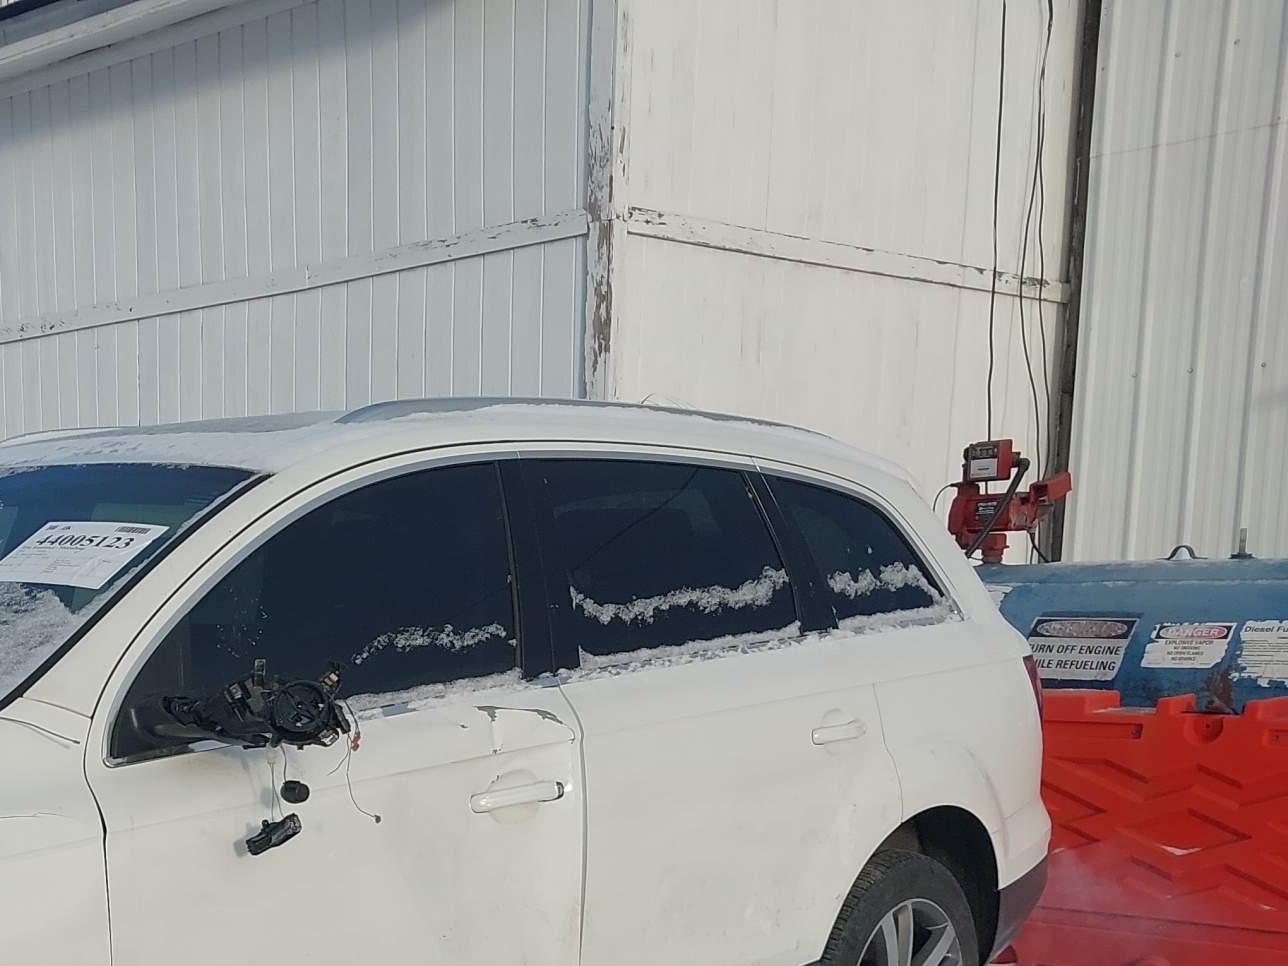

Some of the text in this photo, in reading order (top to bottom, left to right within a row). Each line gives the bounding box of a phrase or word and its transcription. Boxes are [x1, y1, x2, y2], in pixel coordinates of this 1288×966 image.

[35, 534, 135, 549] 44005123
[1164, 628, 1219, 637] DANGER
[1244, 625, 1275, 633] Diesel
[1029, 643, 1122, 656] URN OFF ENGINE
[1034, 658, 1117, 672] ILE REFUELING
